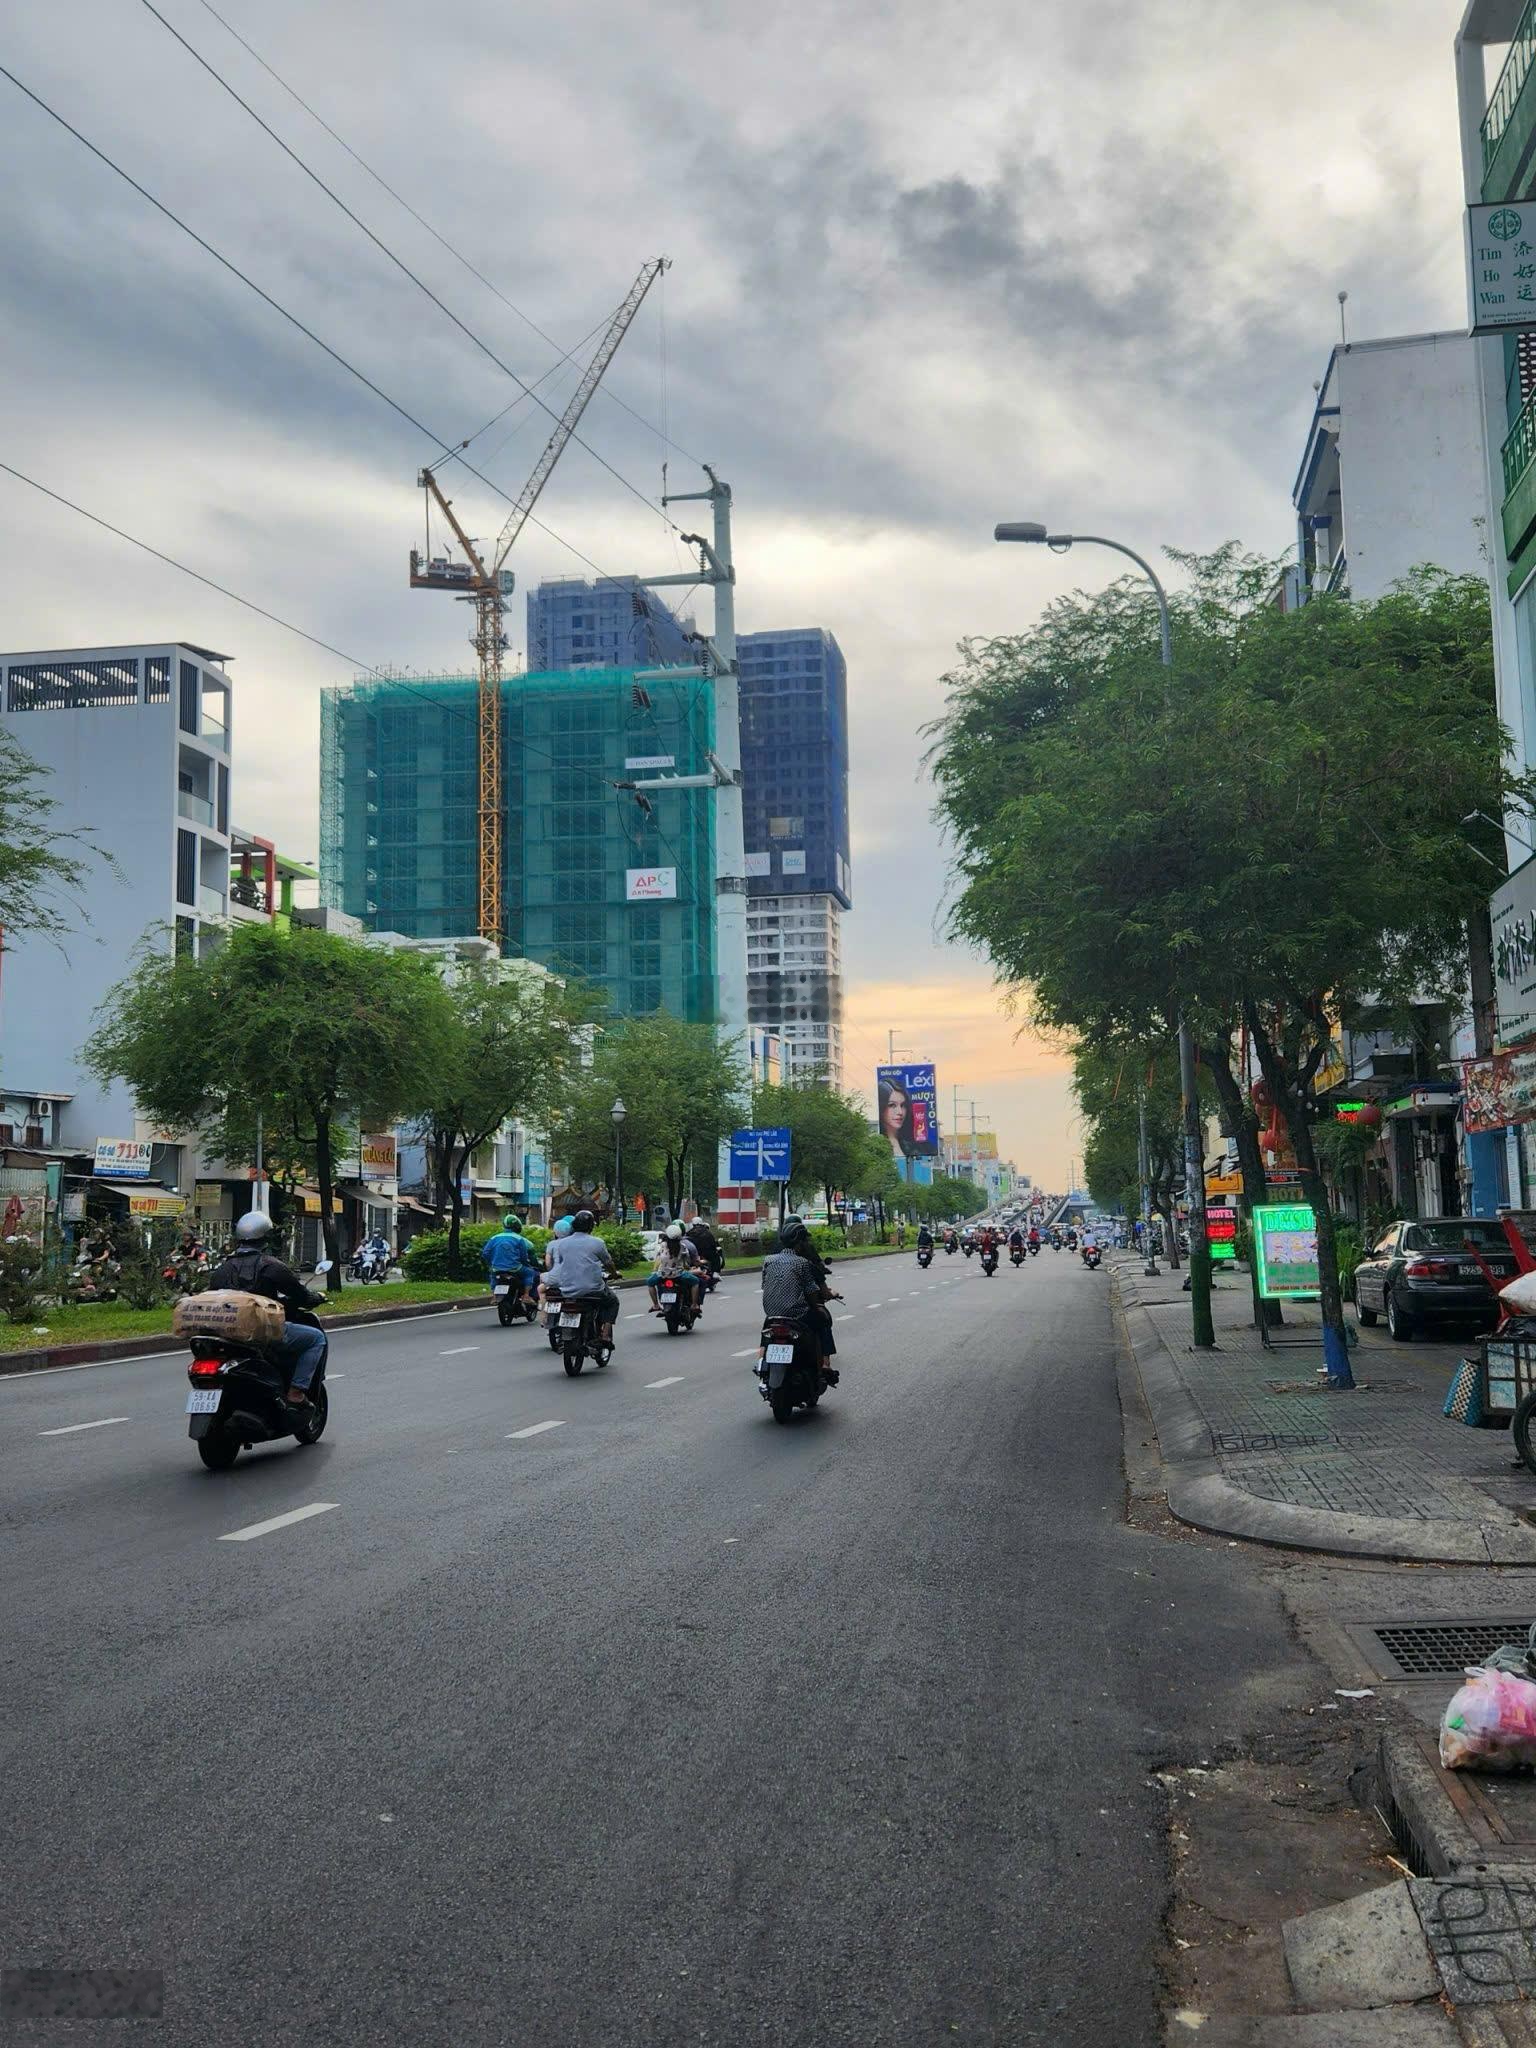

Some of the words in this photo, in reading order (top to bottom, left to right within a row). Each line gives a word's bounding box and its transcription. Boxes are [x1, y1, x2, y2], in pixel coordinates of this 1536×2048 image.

[1478, 248, 1501, 260] Tim
[1484, 270, 1499, 282] Ho
[1481, 292, 1505, 304] Wan
[636, 871, 669, 888] APC
[905, 1070, 934, 1088] Léxi
[1207, 1209, 1236, 1219] HOTEL
